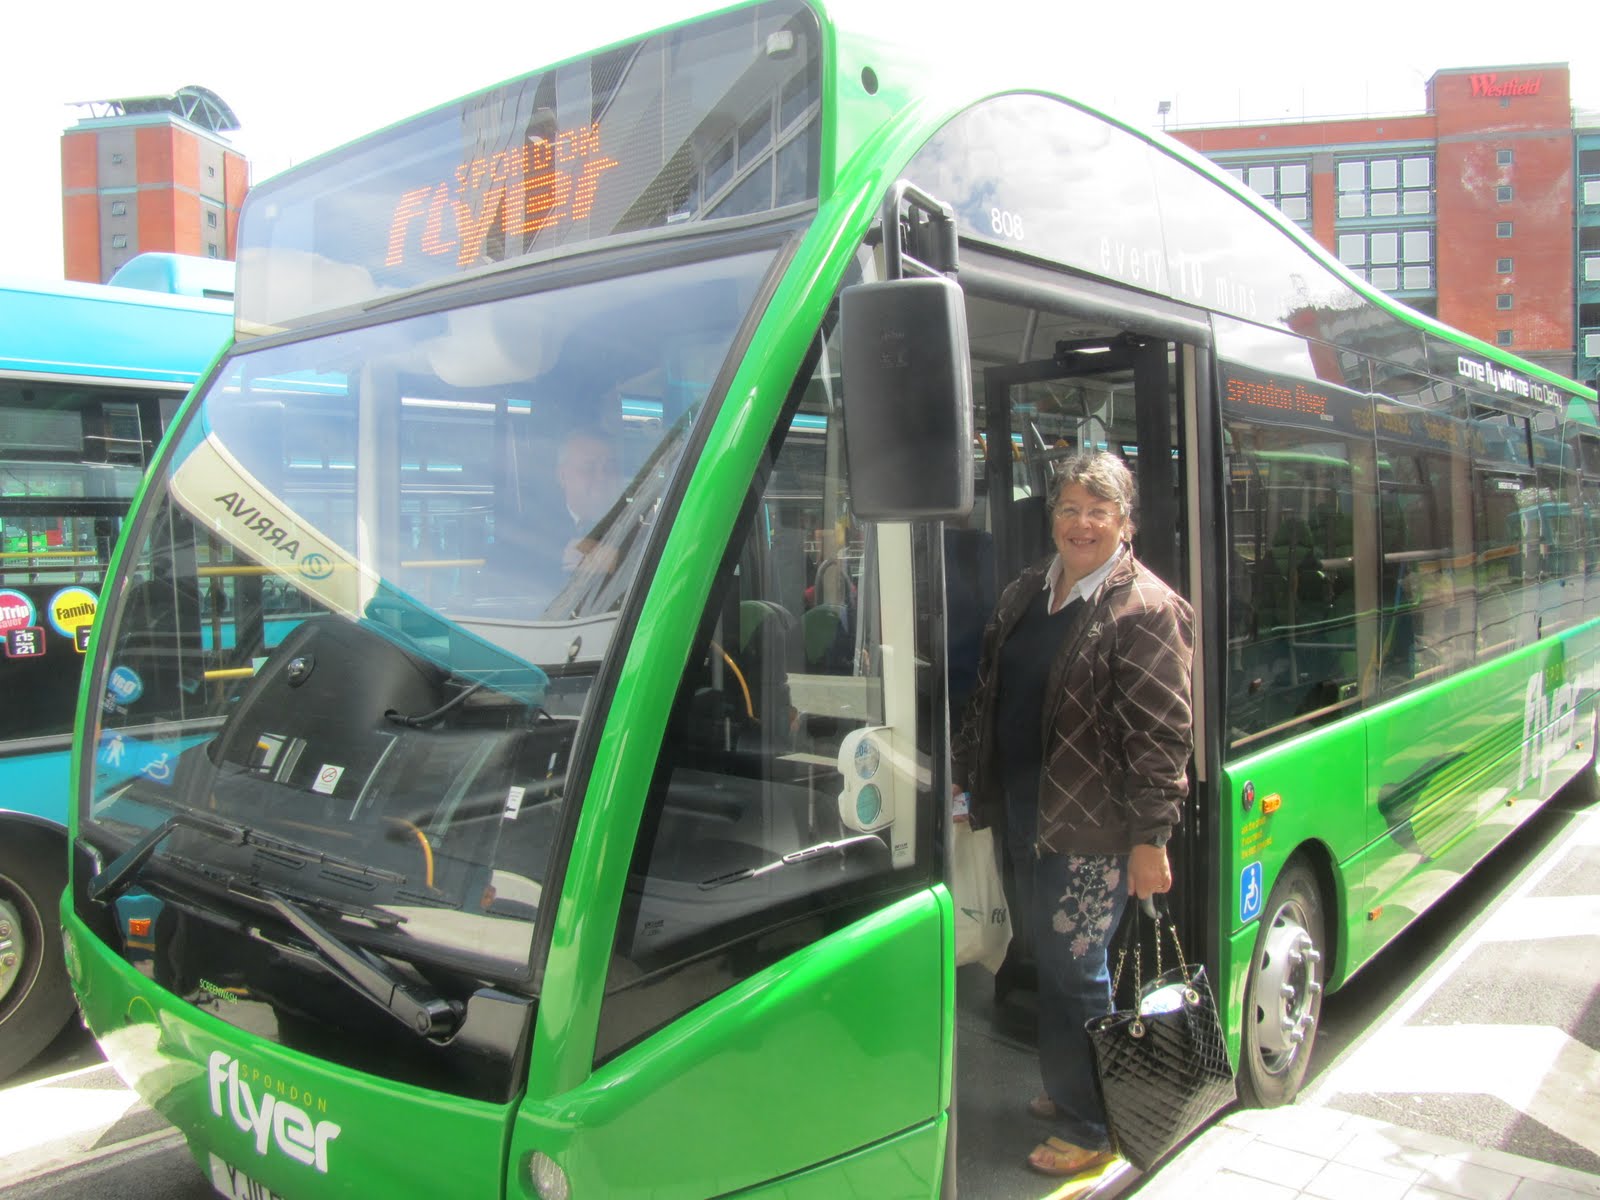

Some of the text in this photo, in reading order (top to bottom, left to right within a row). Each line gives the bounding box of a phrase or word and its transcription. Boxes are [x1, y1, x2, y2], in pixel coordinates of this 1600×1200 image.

[1469, 73, 1544, 97] Westfield
[454, 122, 600, 194] SPONDON
[990, 207, 1025, 241] 808
[1100, 237, 1166, 292] every
[1173, 252, 1204, 298] 10
[1215, 272, 1258, 317] mins
[1457, 355, 1563, 413] come fly with me into Derby
[56, 602, 96, 621] Family
[15, 644, 35, 655] £21
[199, 978, 238, 1005] SCREENWASH
[241, 1063, 327, 1113] SPONDON
[208, 1050, 342, 1174] flyer
